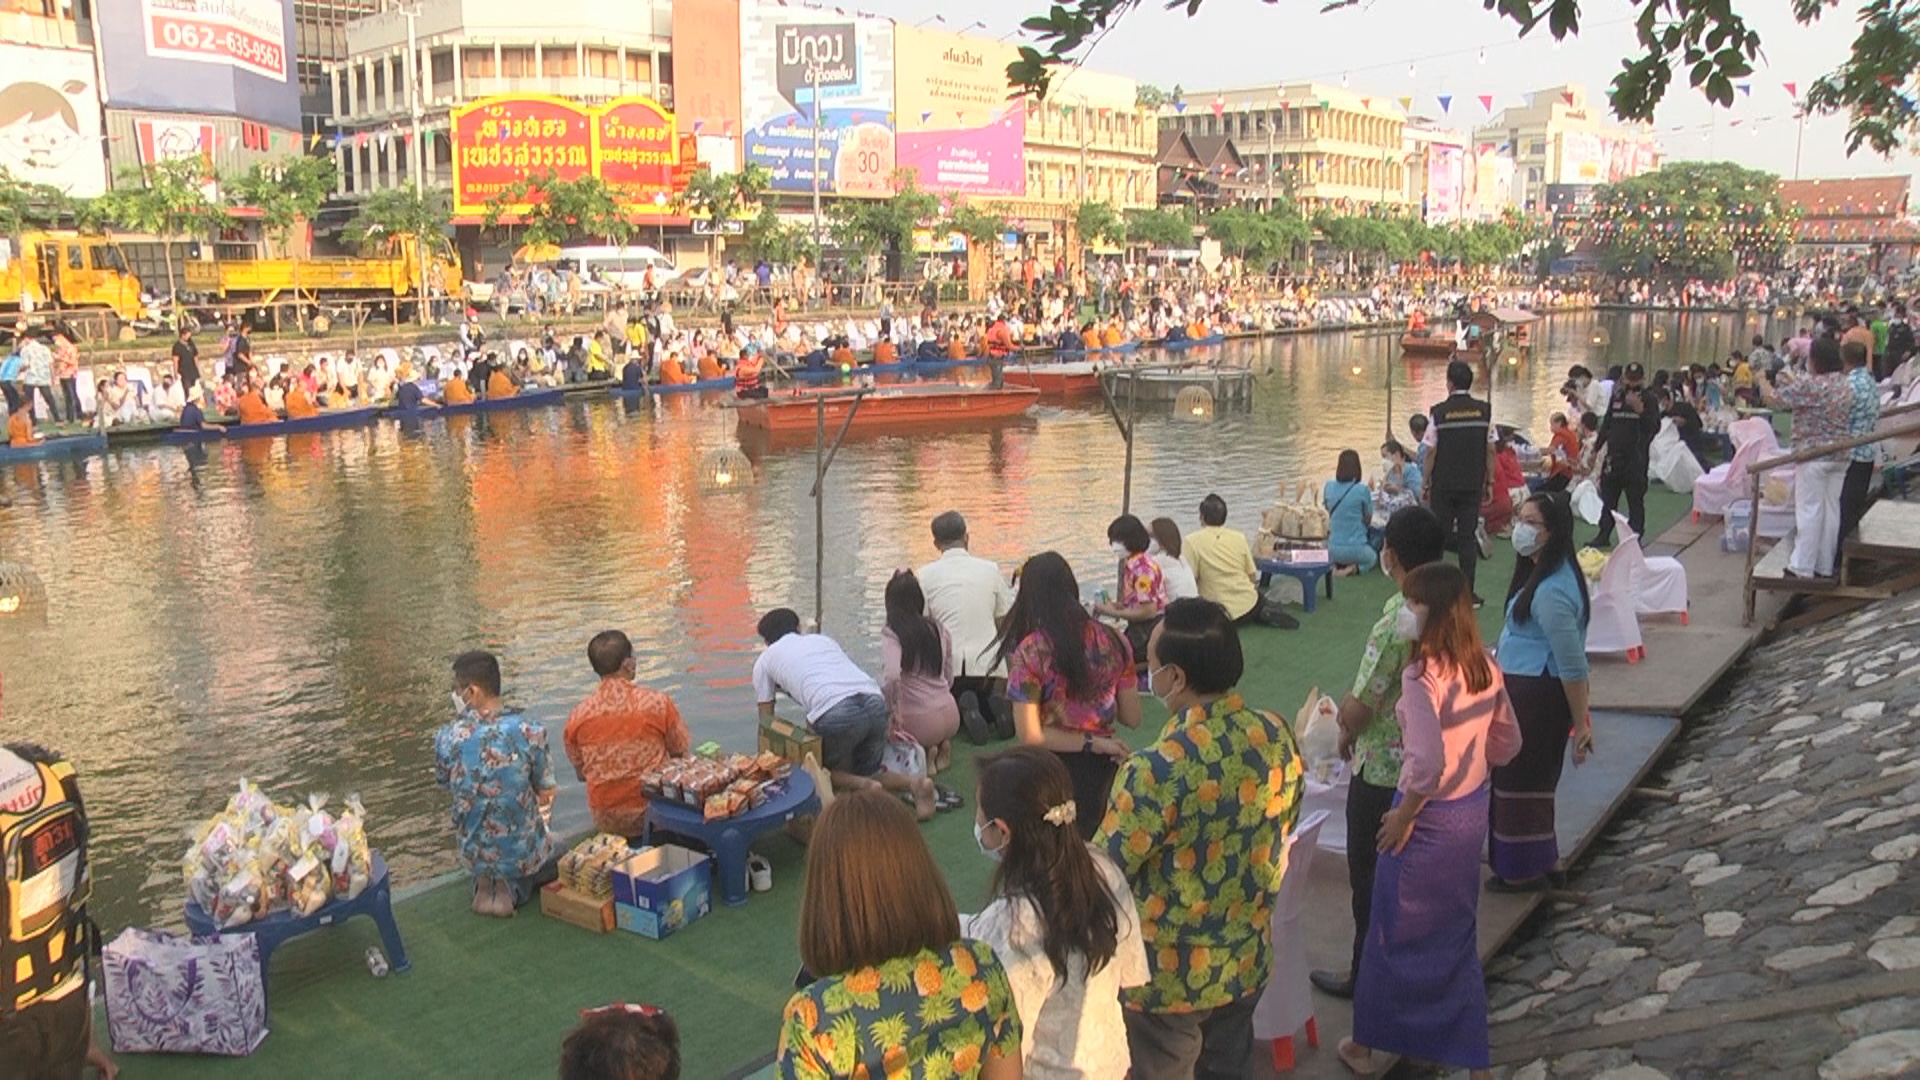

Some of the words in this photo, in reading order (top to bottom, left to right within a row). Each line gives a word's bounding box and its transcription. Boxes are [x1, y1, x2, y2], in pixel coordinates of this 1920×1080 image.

[163, 22, 280, 69] 062-635-9562
[481, 105, 567, 139] ห้างทอง
[462, 141, 588, 178] เพชรสุวรรณ
[858, 151, 880, 175] 30
